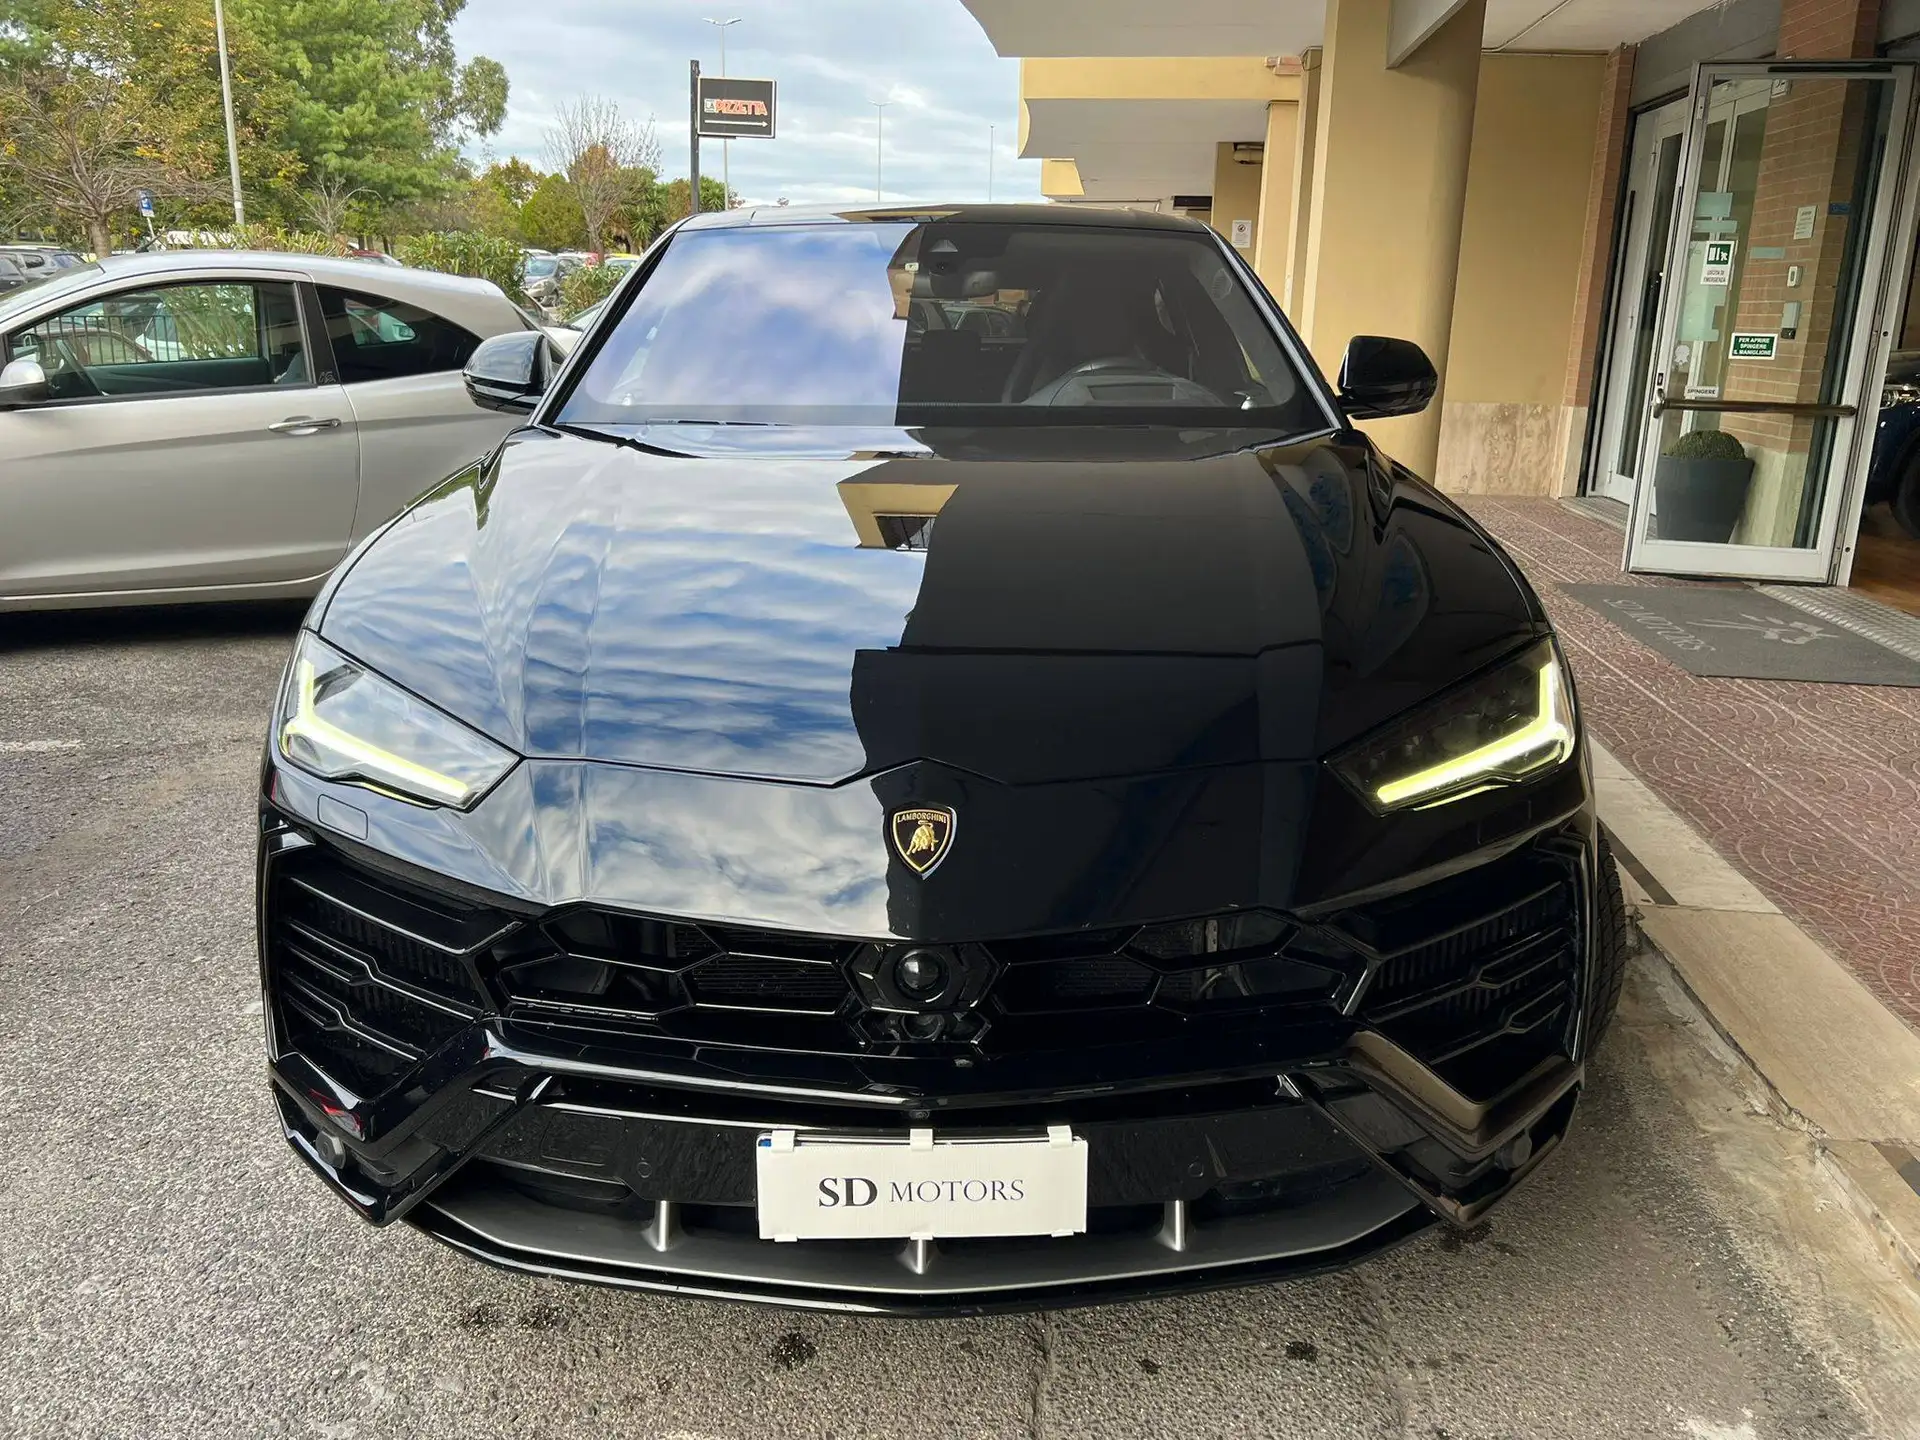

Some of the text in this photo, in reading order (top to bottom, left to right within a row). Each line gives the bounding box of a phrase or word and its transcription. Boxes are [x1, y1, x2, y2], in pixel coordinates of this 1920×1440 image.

[897, 812, 947, 824] LAMBORGHINI
[818, 1177, 1025, 1208] SD MOTORS
